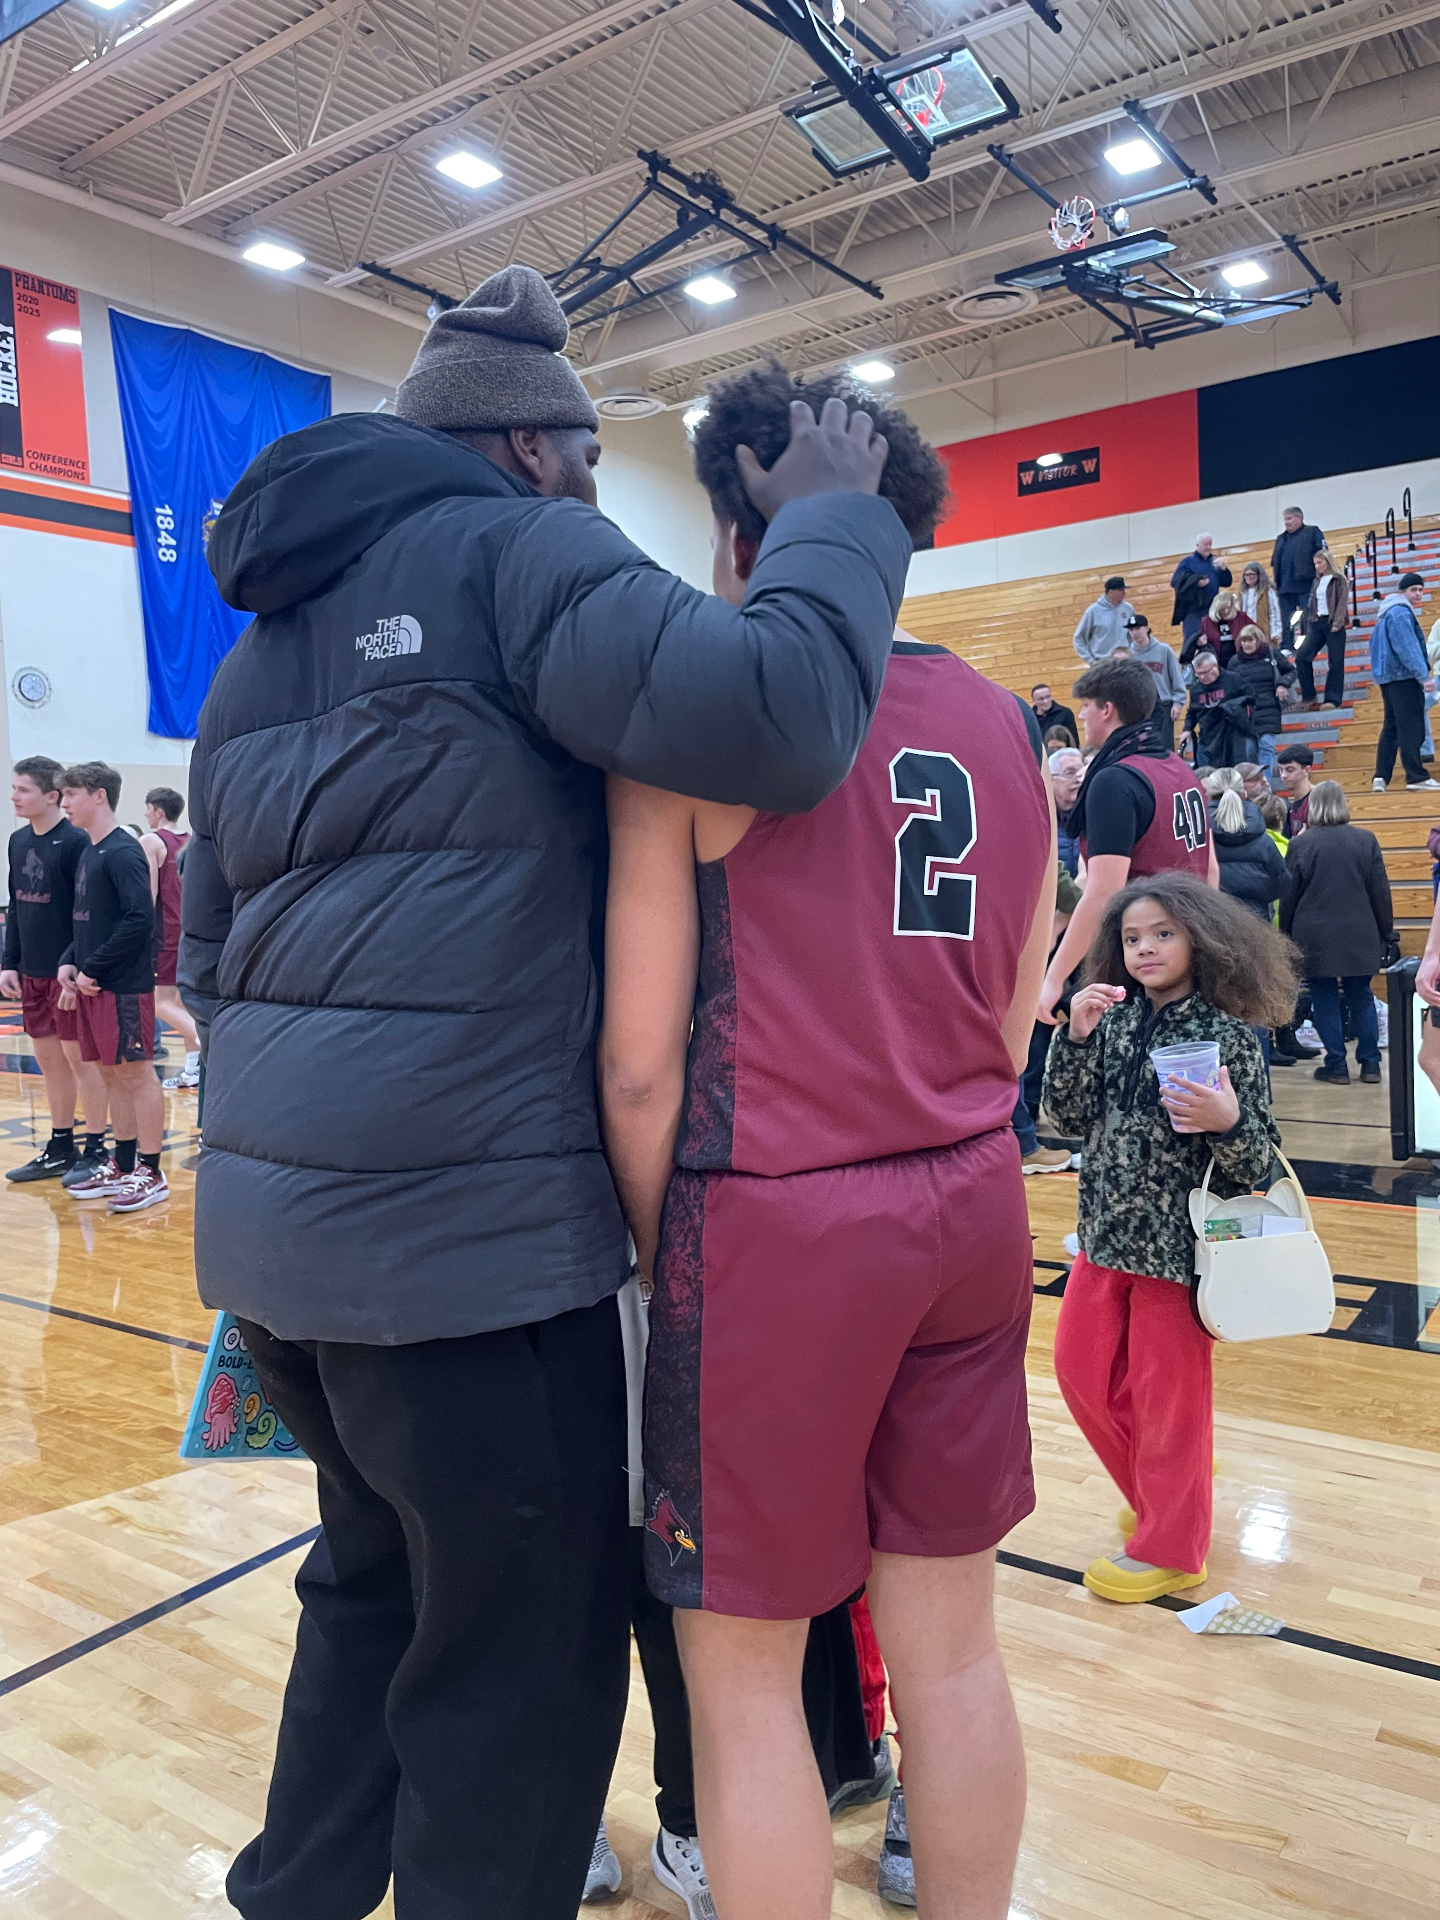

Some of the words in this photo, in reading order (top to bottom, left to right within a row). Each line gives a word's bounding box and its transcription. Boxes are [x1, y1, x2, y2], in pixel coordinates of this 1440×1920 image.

[14, 272, 77, 304] PHANTOMS
[16, 292, 39, 305] 2020
[17, 303, 41, 317] 2025
[26, 449, 87, 470] CONFERENCE
[29, 461, 86, 481] CHAMPIONS
[1020, 470, 1035, 486] W
[1081, 458, 1098, 474] W
[154, 503, 178, 563] 1848
[376, 615, 401, 633] THE
[355, 629, 399, 651] NORTH
[364, 642, 397, 661] FACE
[1172, 786, 1207, 853] 40
[888, 747, 978, 941] 2
